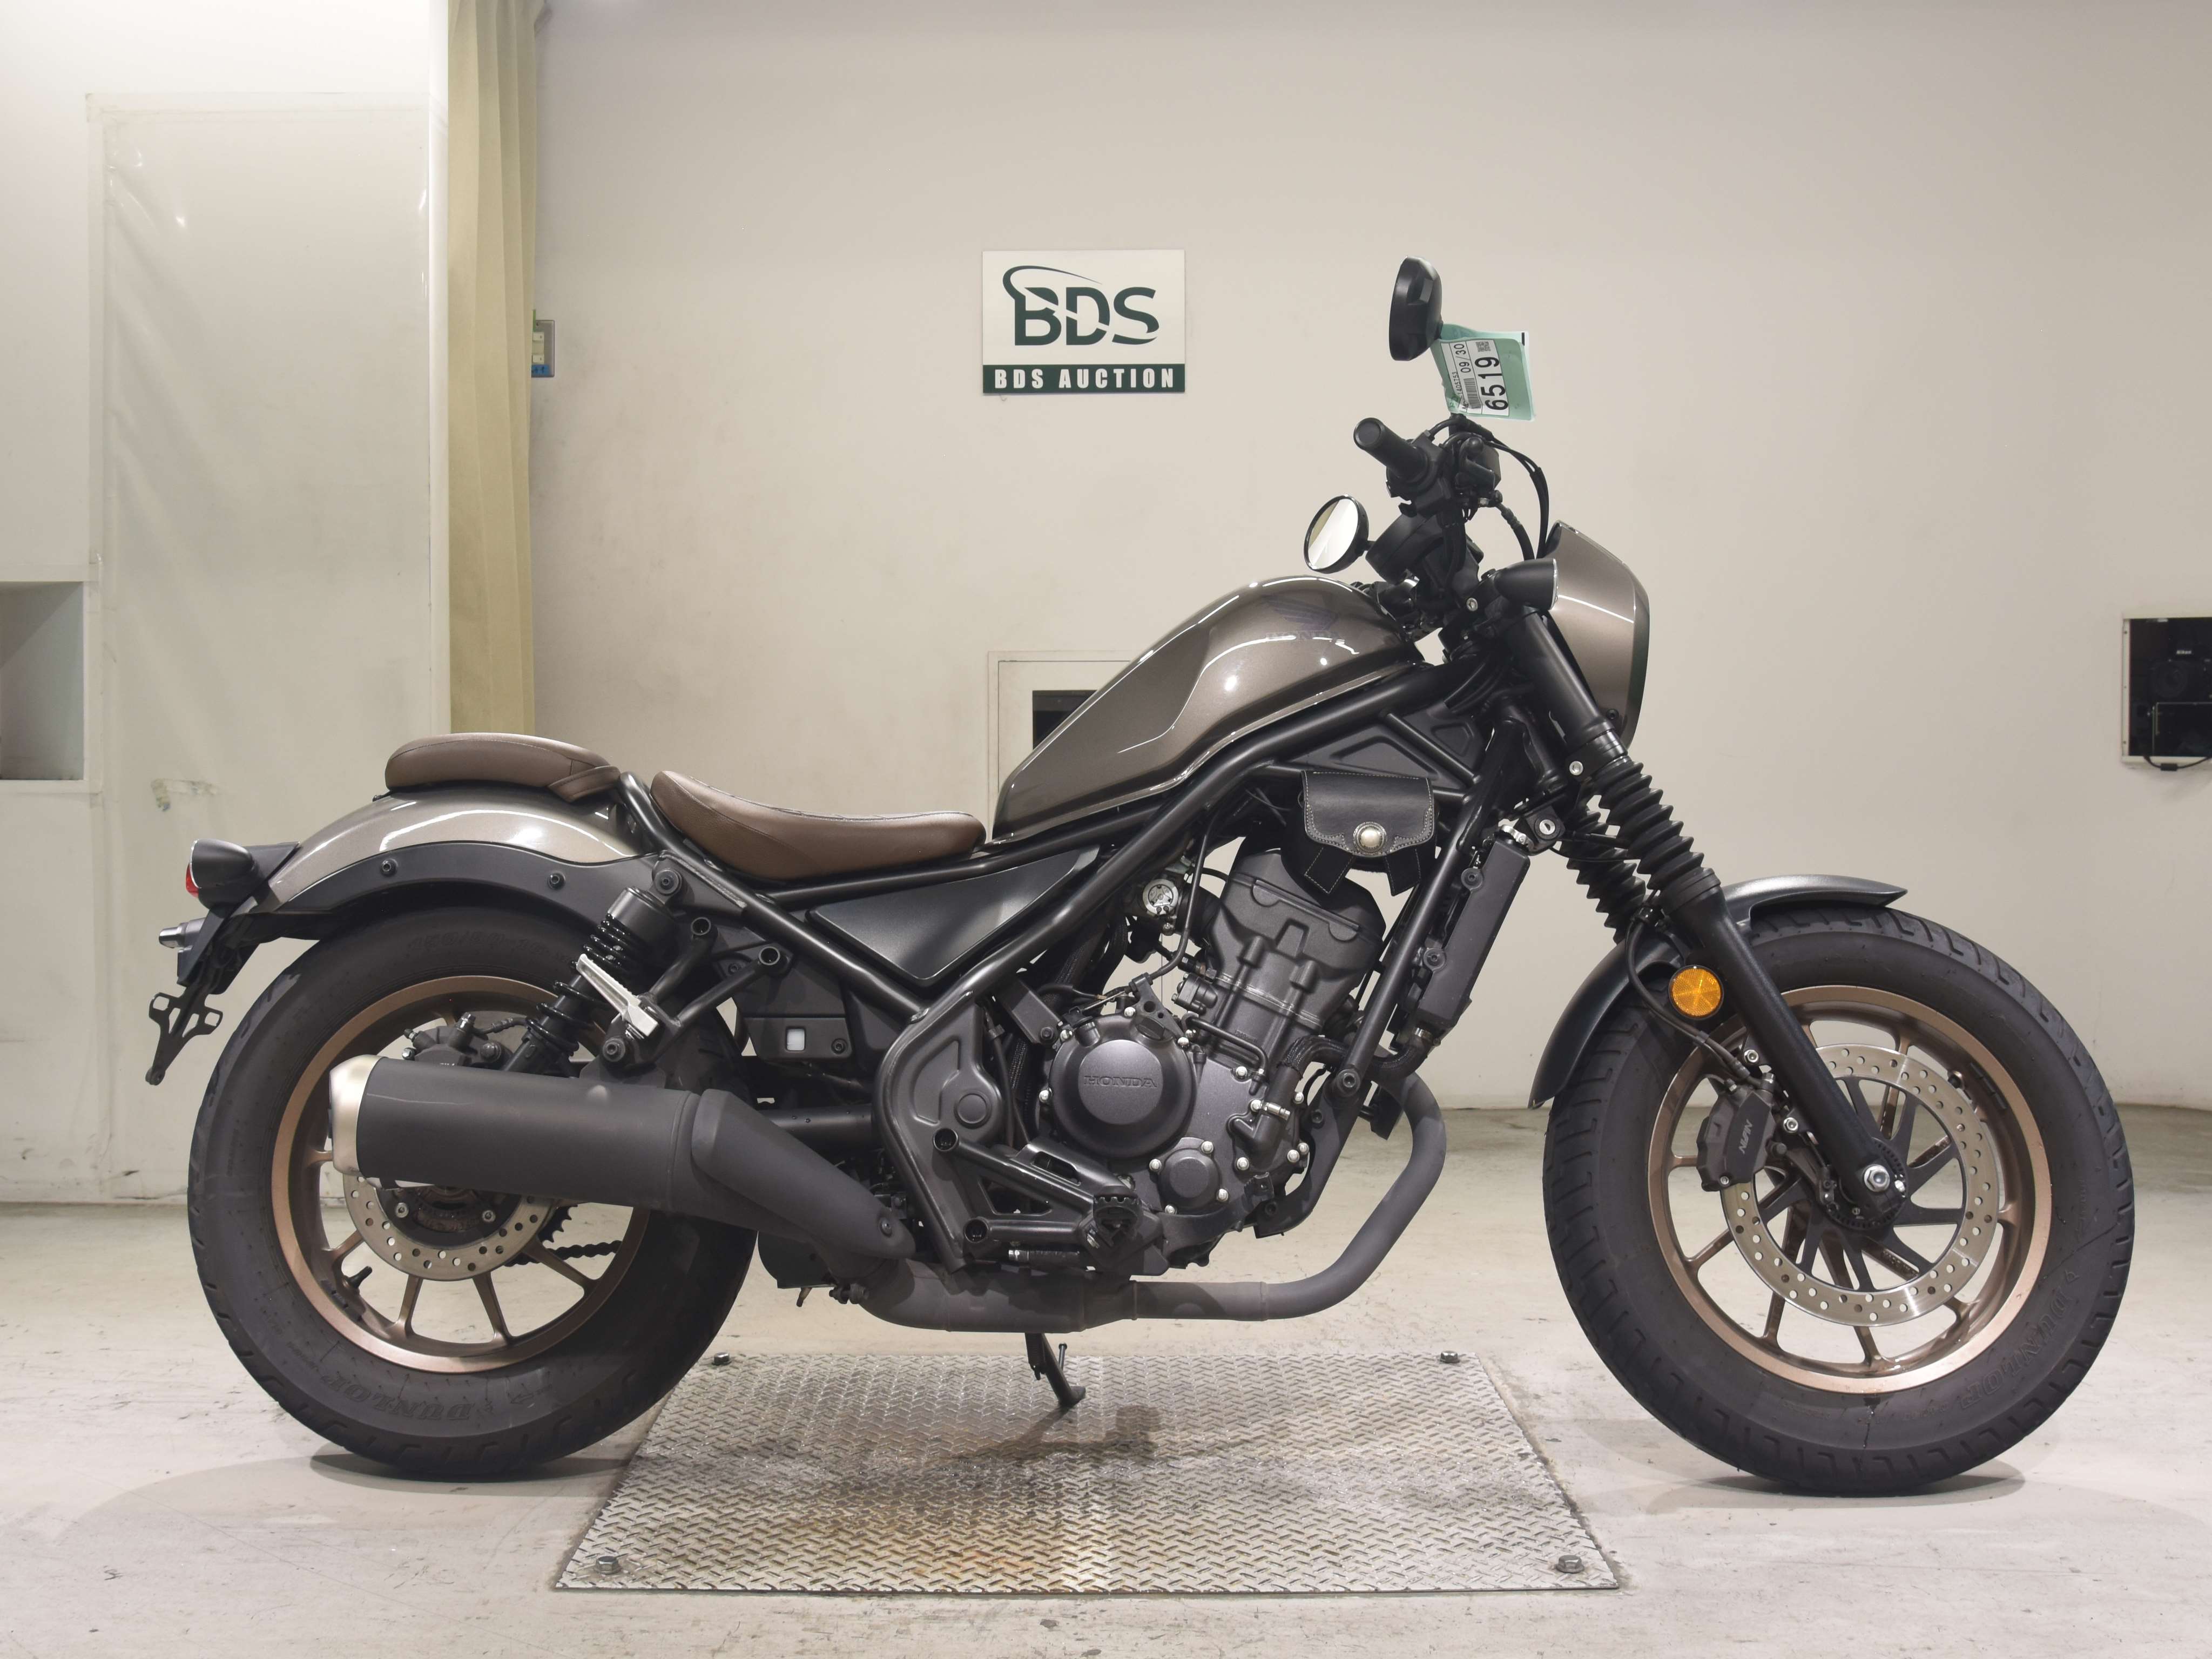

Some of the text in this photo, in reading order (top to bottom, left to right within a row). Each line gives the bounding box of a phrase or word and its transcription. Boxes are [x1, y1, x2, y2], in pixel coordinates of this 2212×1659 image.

[1002, 265, 1159, 346] BDS
[994, 368, 1173, 388] BDS AUCTION
[1454, 343, 1471, 373] 09/30
[1474, 356, 1508, 410] 6519
[1084, 1076, 1157, 1088] HONDA
[1960, 1290, 2074, 1409] DUNLOP
[319, 1373, 475, 1421] DUNLOP
